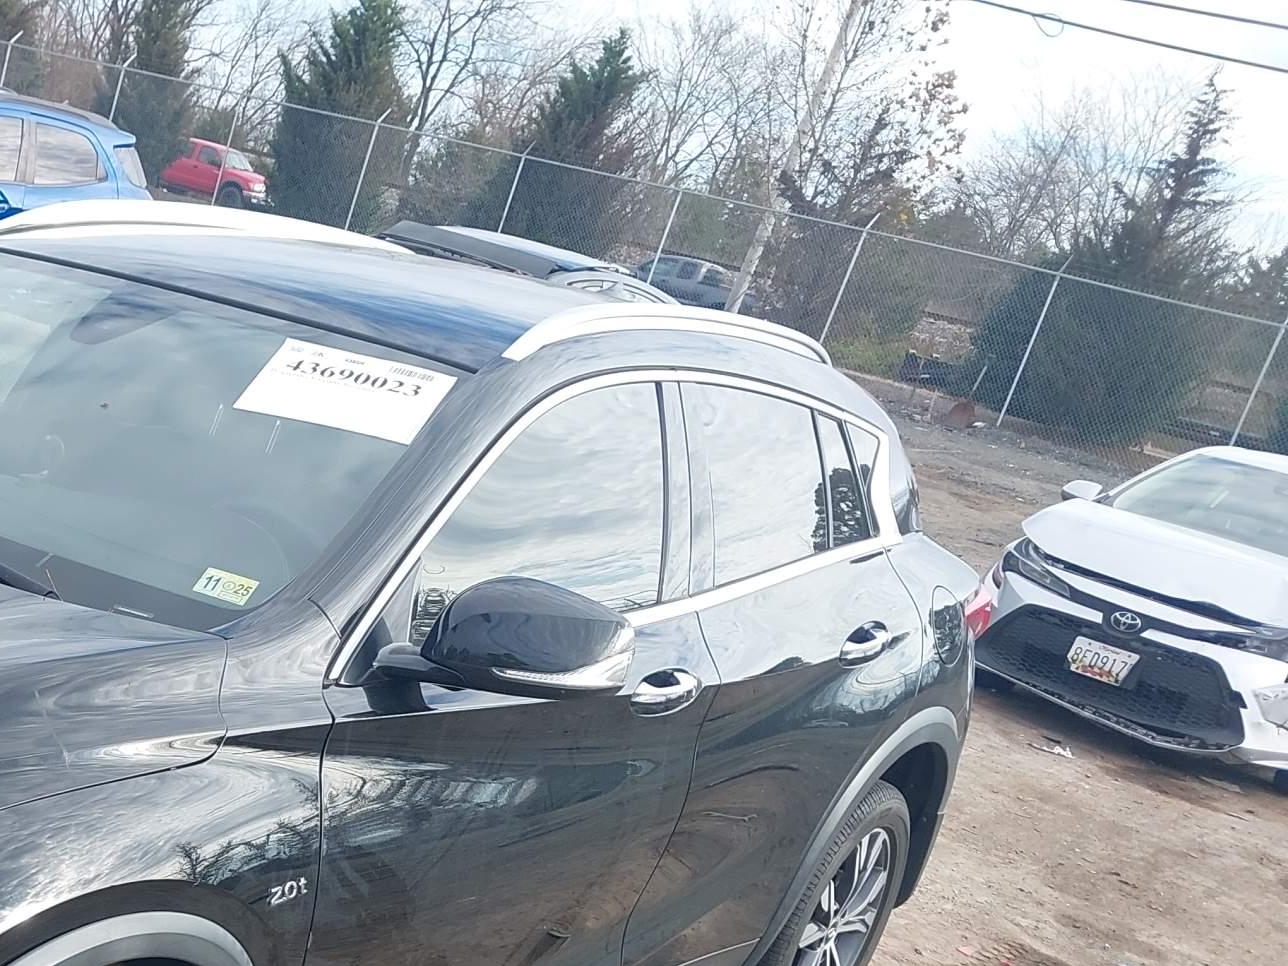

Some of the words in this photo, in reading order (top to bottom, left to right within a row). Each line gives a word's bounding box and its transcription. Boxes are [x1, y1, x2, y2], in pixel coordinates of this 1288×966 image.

[286, 359, 423, 397] 43690023
[203, 575, 222, 591] 11
[233, 583, 253, 597] 25
[1071, 646, 1132, 677] 8FD917
